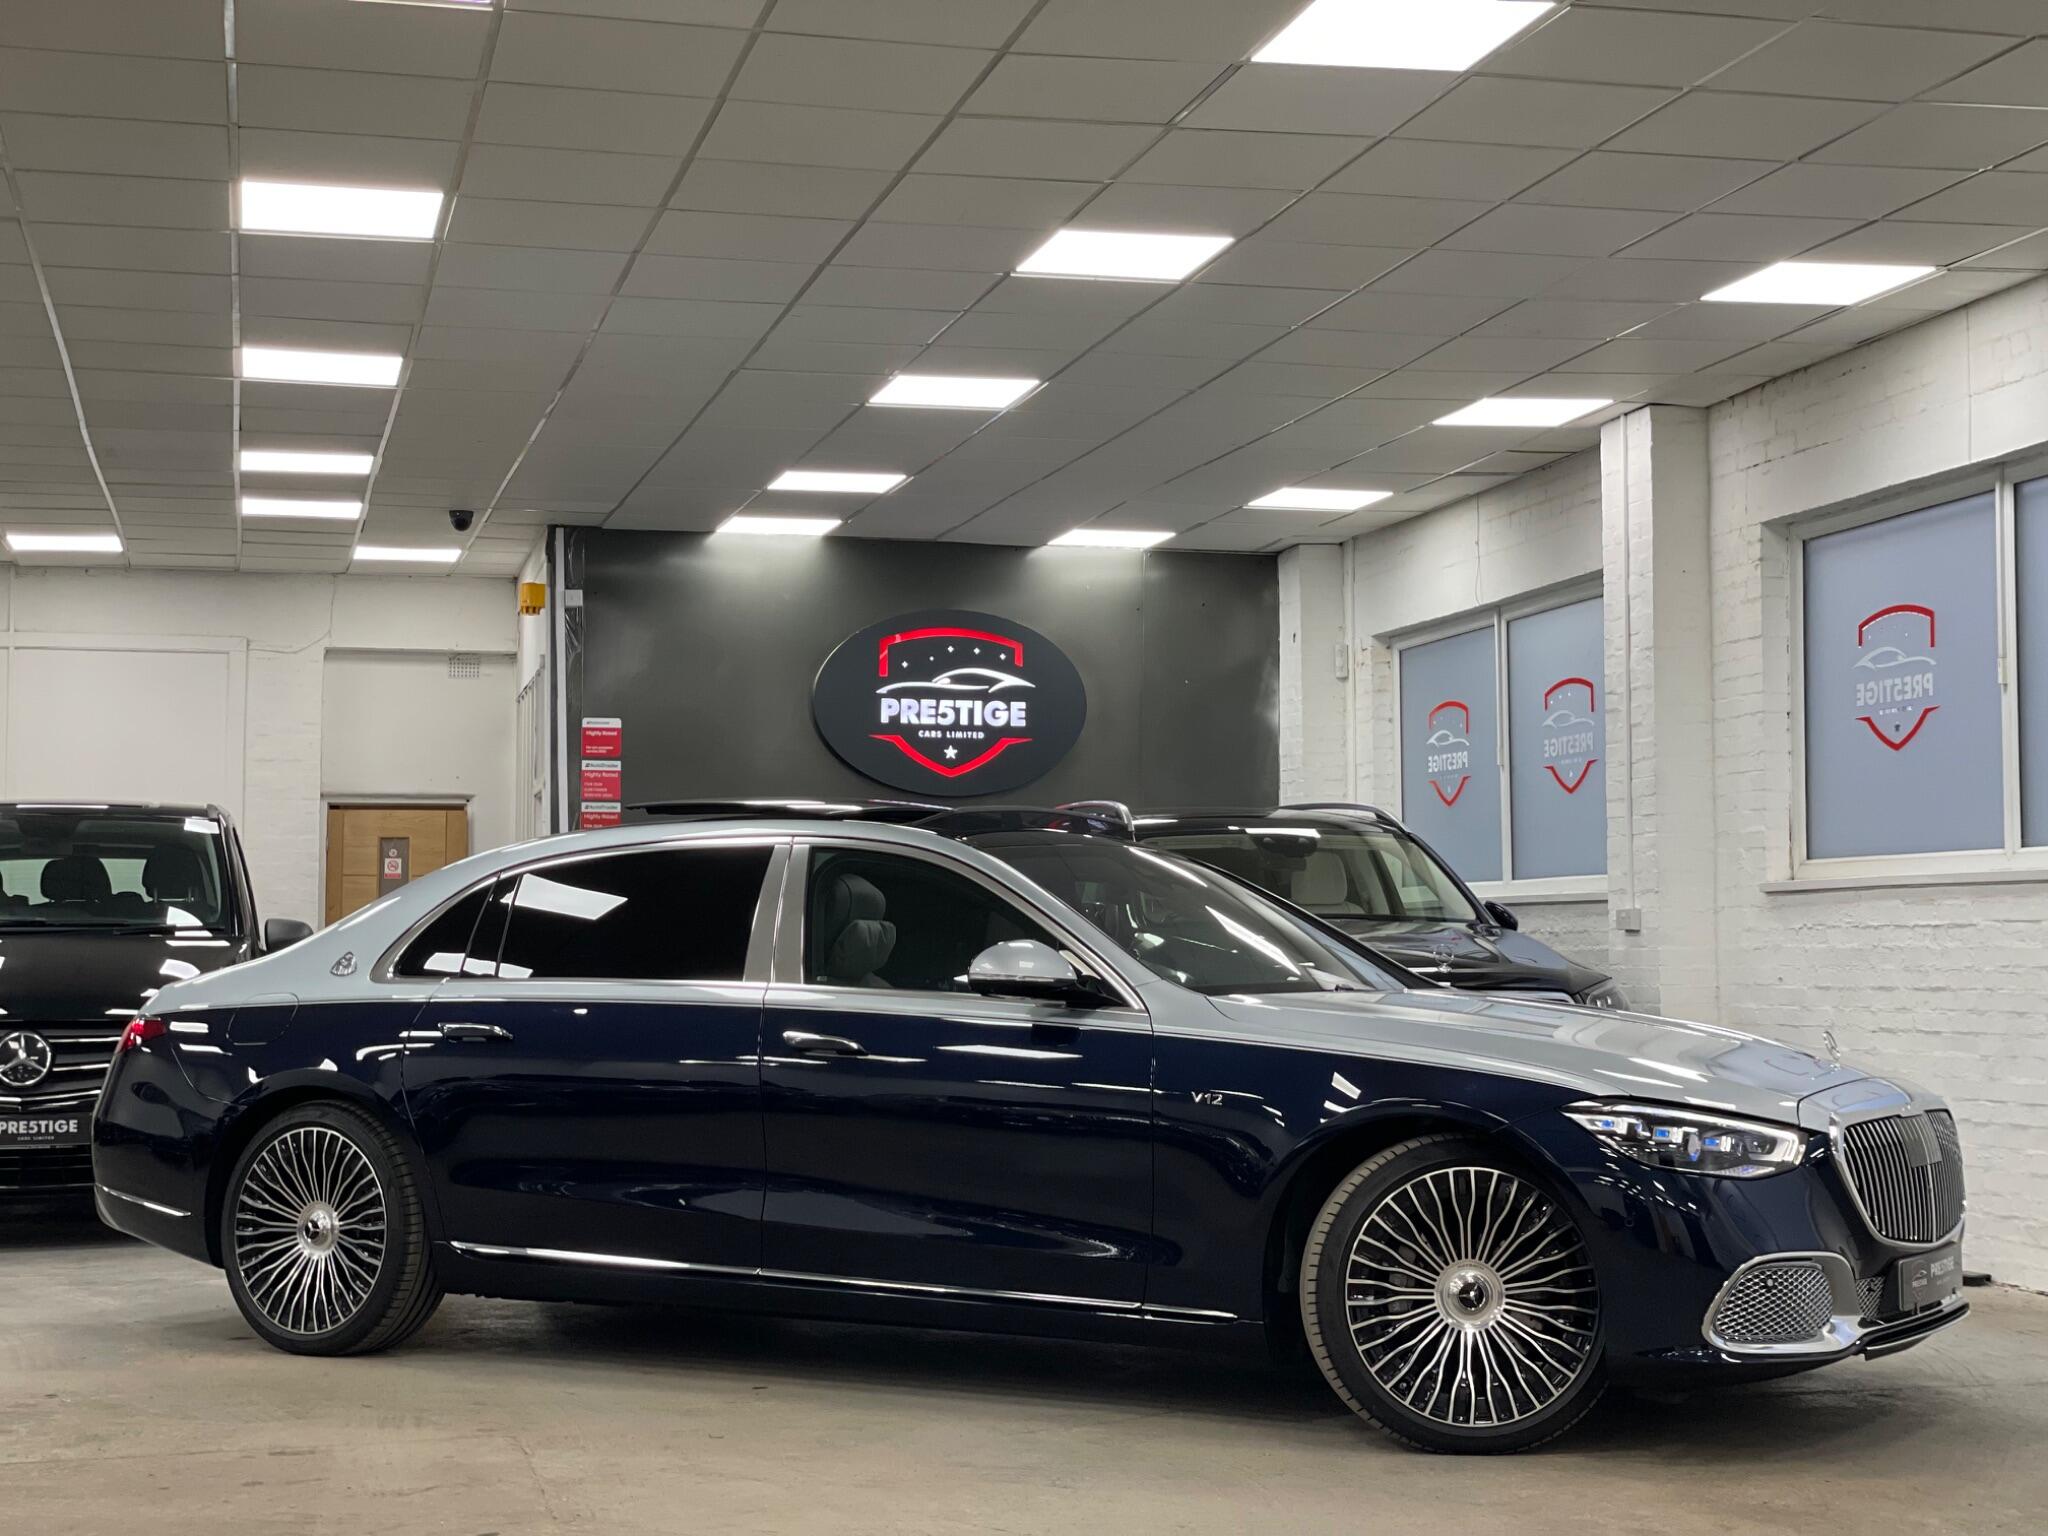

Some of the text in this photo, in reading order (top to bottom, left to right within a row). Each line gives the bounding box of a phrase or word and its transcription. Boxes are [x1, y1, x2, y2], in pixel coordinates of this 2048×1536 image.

[918, 730, 985, 739] CARS LIMITED
[1191, 1091, 1223, 1105] V12
